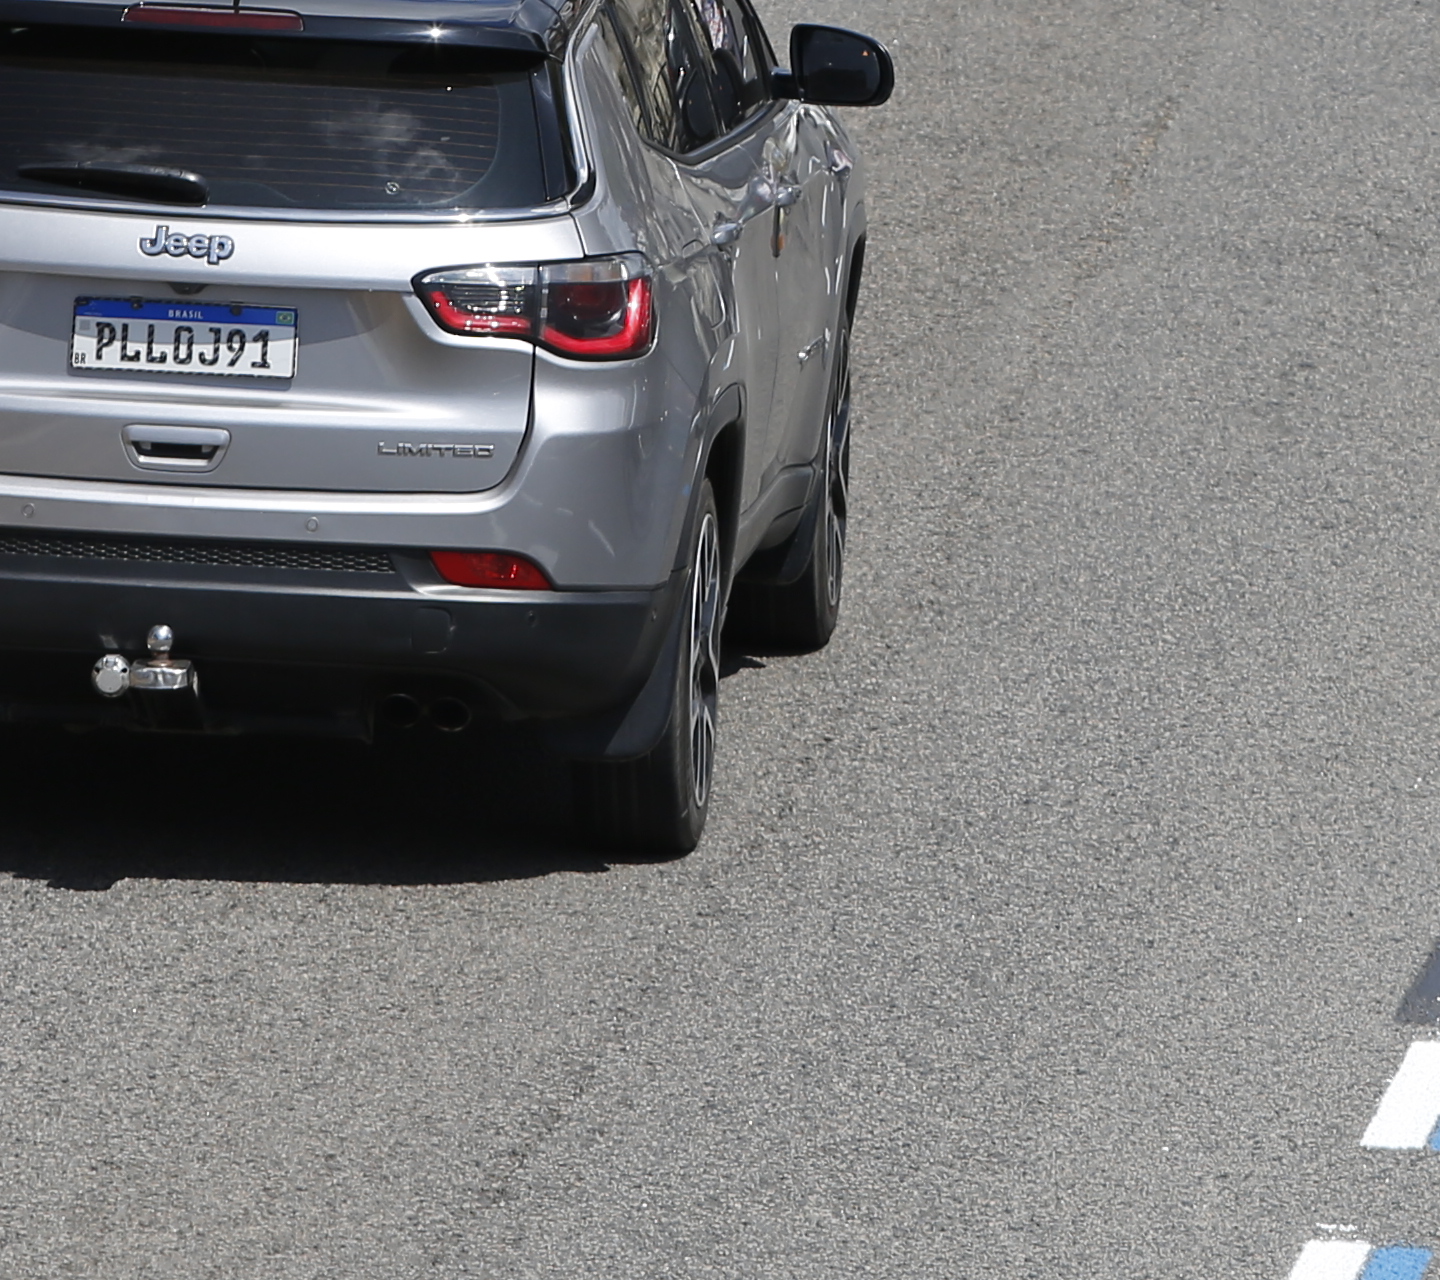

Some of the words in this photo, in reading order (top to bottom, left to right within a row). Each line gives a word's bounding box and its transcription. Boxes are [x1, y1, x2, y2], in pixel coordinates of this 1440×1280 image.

[139, 224, 236, 265] Jeep
[168, 308, 204, 320] BRASIL
[94, 321, 271, 370] PLL0J91
[74, 351, 86, 365] BR
[377, 441, 496, 458] LIMITED
